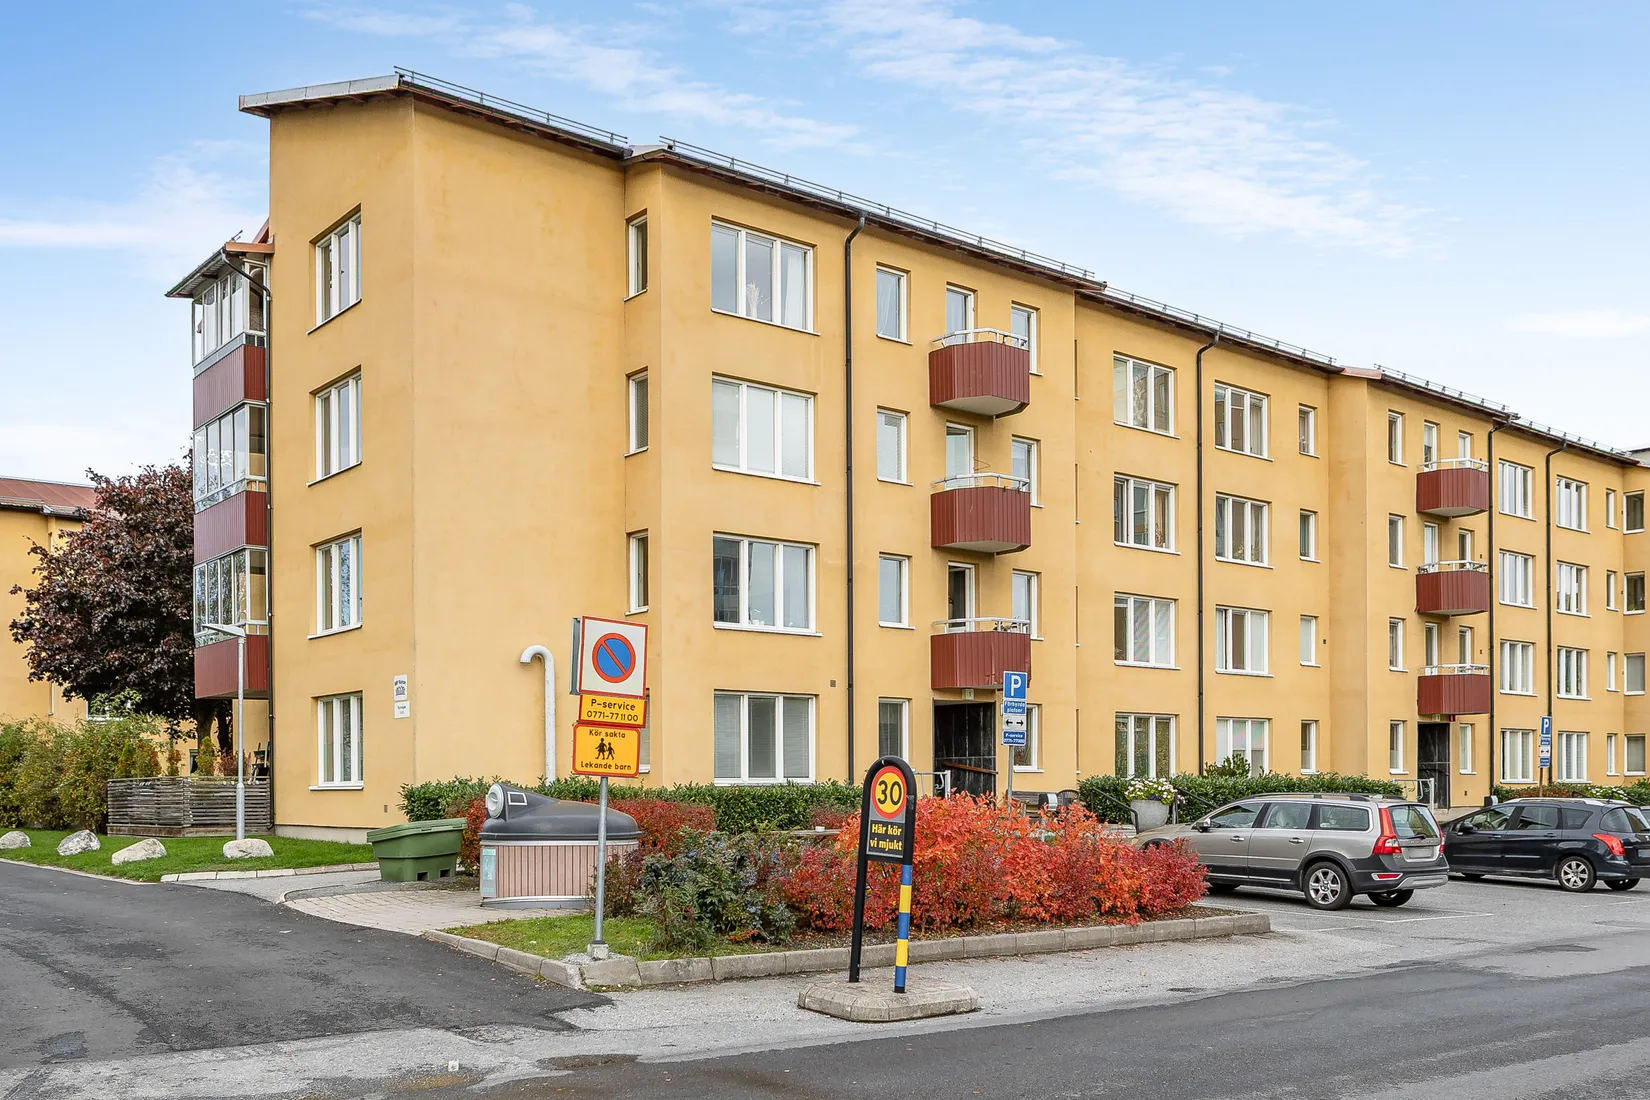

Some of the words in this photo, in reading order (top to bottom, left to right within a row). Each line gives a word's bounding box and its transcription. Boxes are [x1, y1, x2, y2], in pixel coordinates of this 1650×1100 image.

[1010, 674, 1022, 697] P
[590, 698, 636, 711] P-service
[1543, 718, 1550, 734] P
[588, 729, 602, 737] Kör
[604, 731, 626, 739] sakta
[580, 760, 612, 770] Lekande
[614, 762, 632, 771] barn
[877, 780, 902, 806] 30
[871, 823, 886, 834] Här
[887, 824, 902, 836] kör
[869, 837, 878, 848] vi
[878, 838, 903, 852] mjukt
